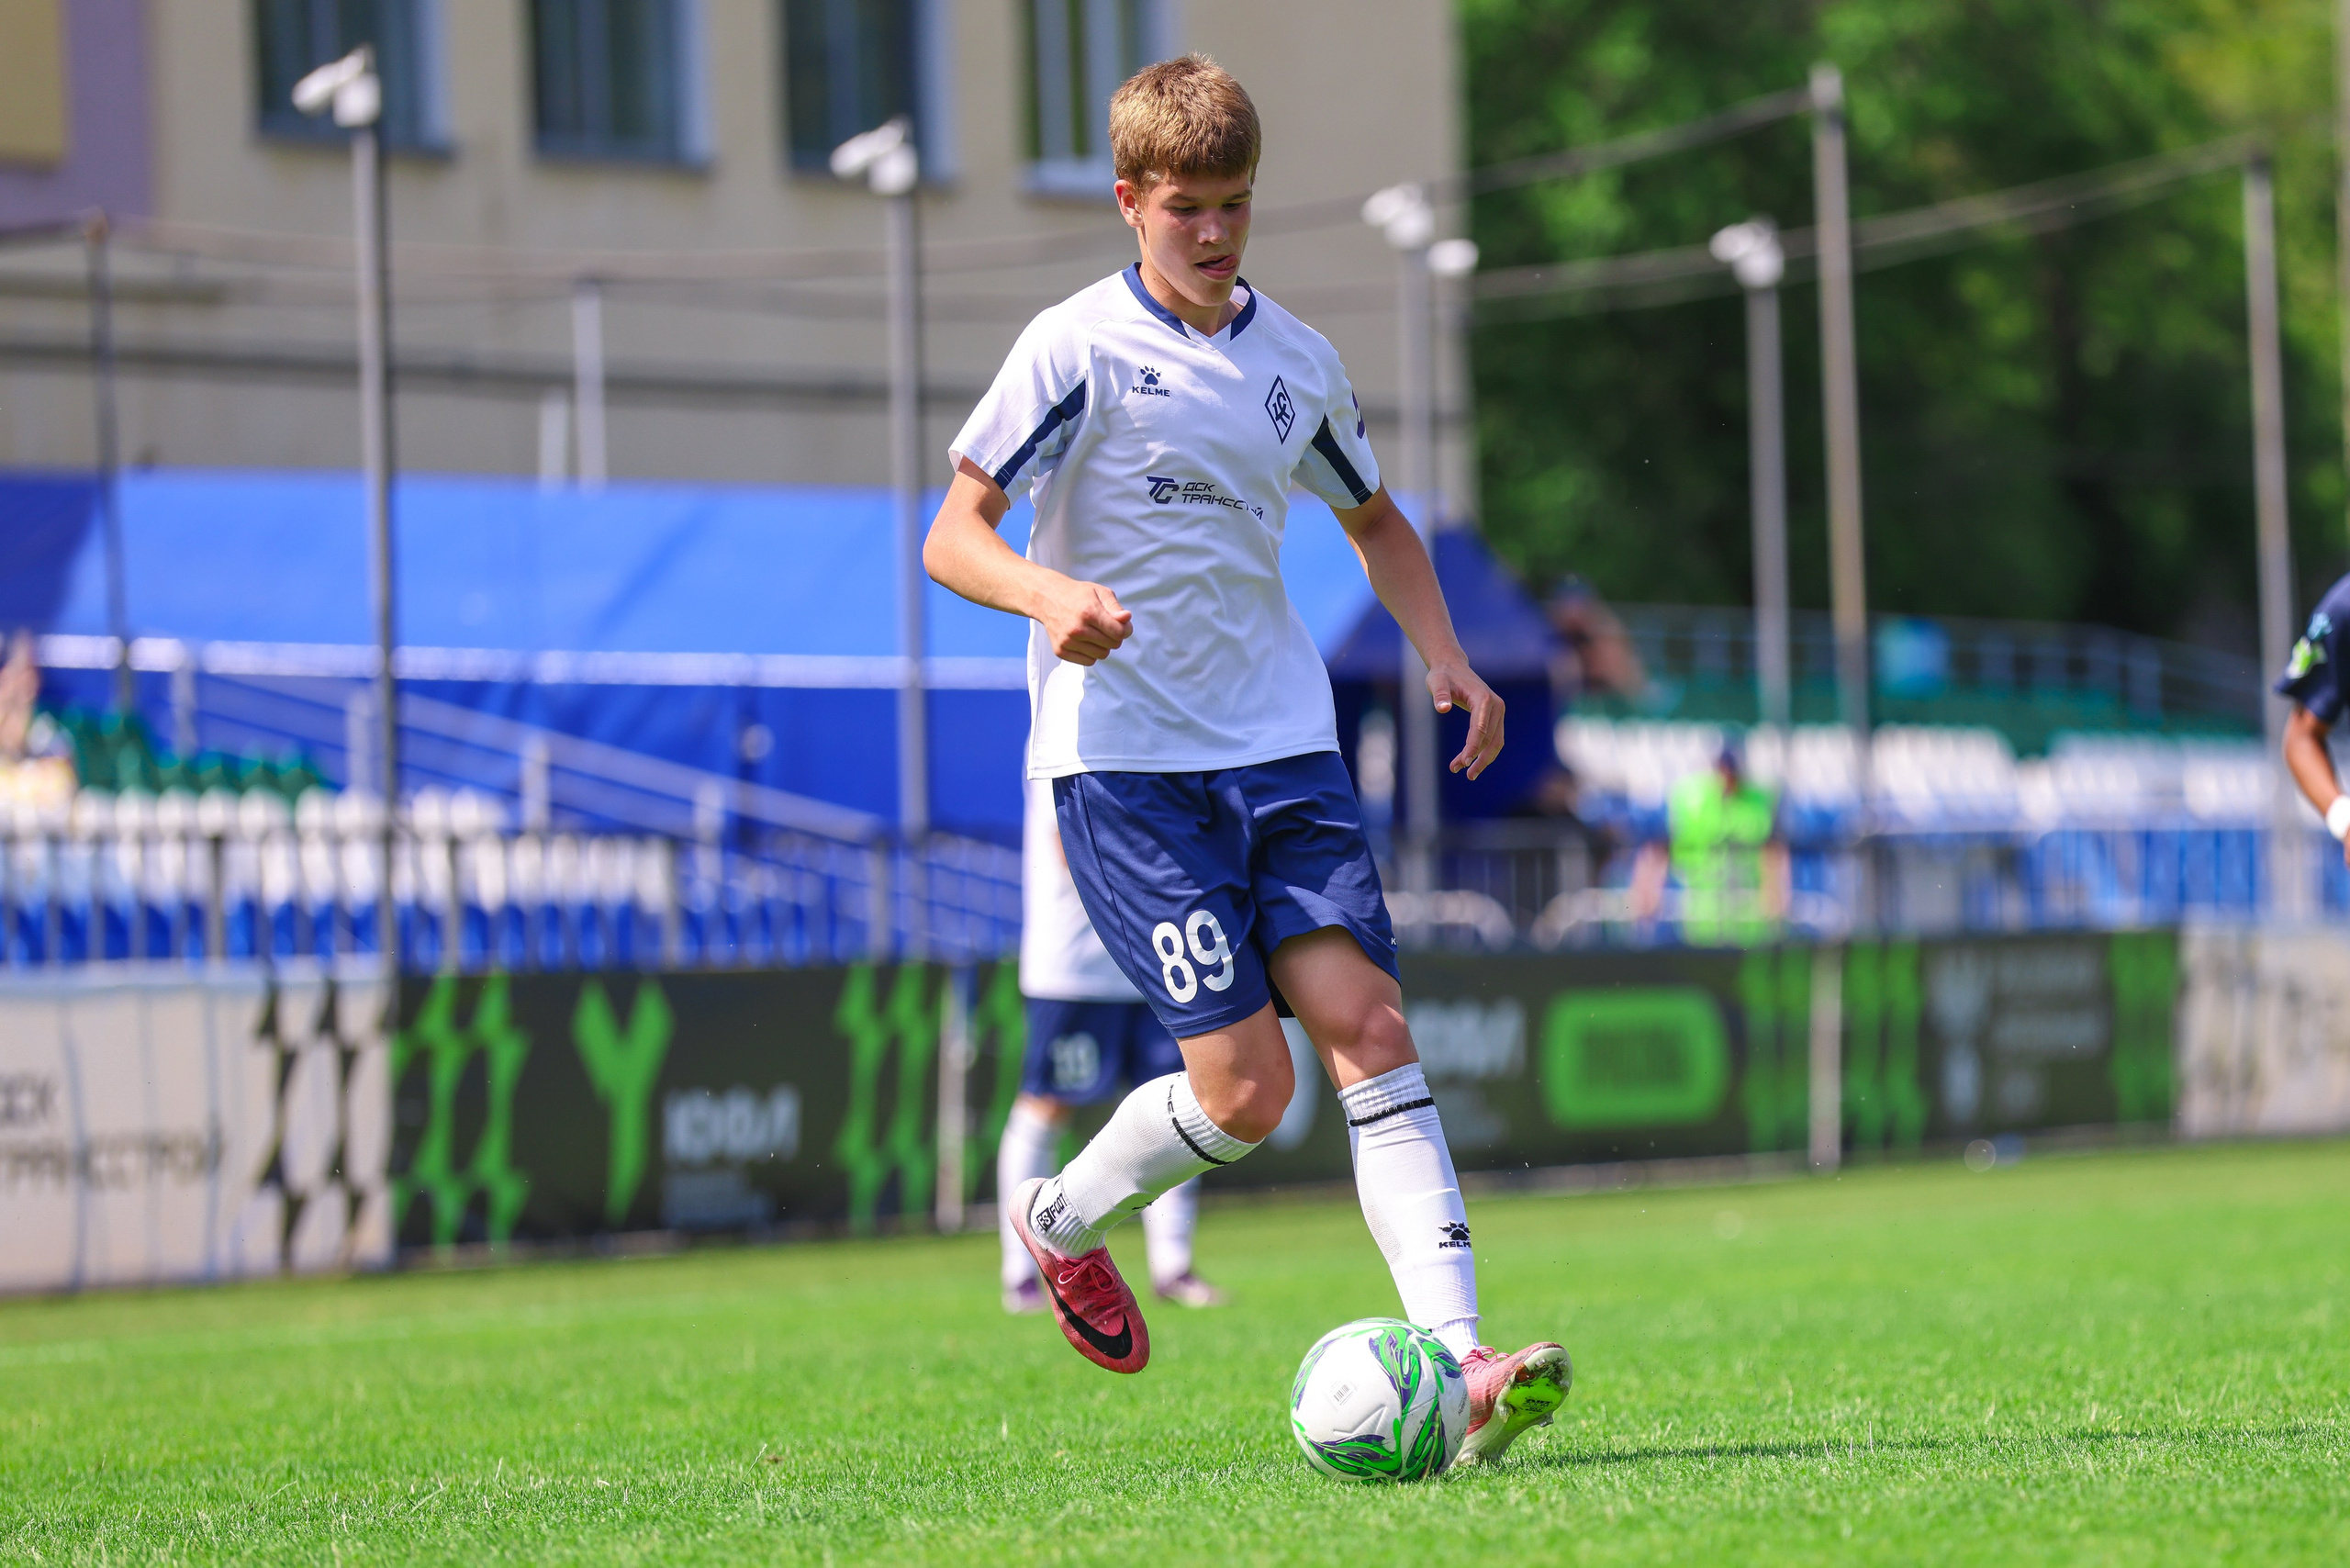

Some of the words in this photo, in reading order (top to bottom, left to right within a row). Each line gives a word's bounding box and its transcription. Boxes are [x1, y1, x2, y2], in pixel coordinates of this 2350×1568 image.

[1132, 386, 1170, 397] KELME
[1182, 482, 1215, 492] ДСК
[1152, 910, 1235, 1002] 89
